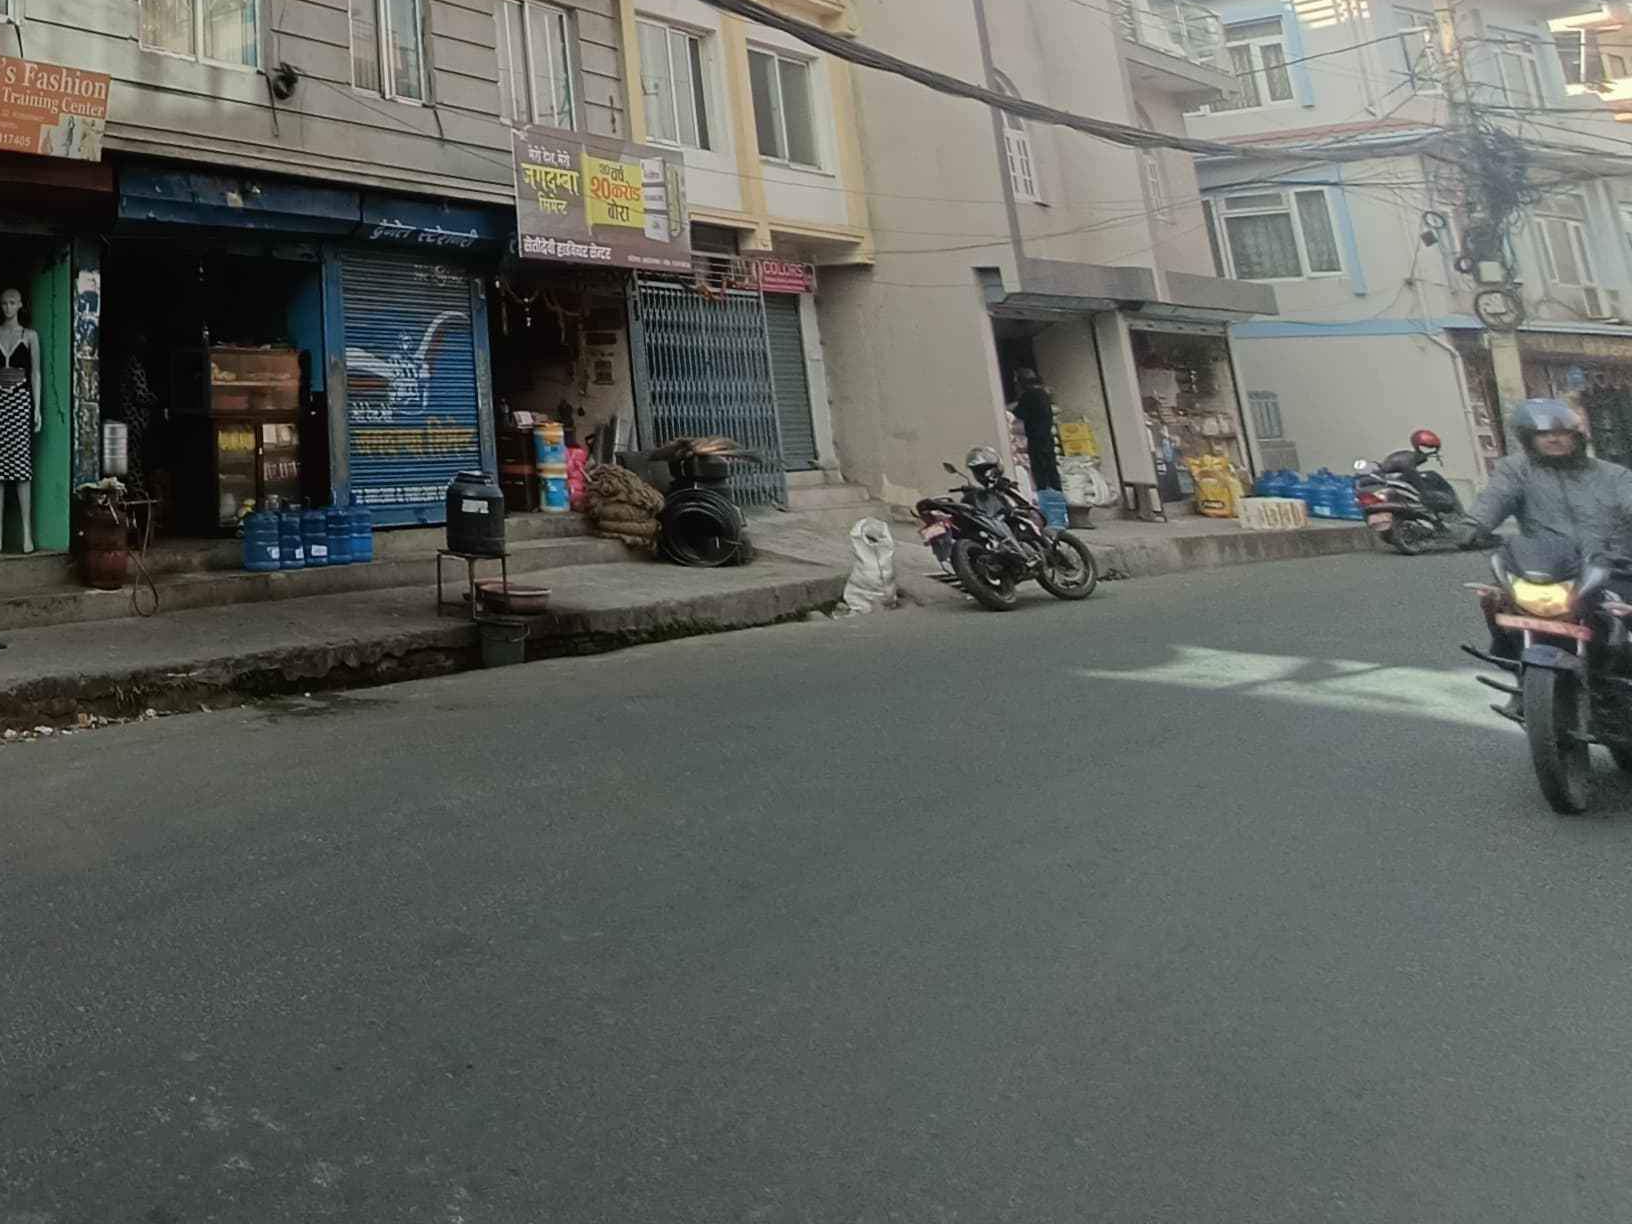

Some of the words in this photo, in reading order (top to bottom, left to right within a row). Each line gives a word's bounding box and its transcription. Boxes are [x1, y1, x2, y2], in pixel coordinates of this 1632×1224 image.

[22, 60, 106, 100] Fashion
[2, 86, 59, 114] Training
[62, 98, 104, 117] Center
